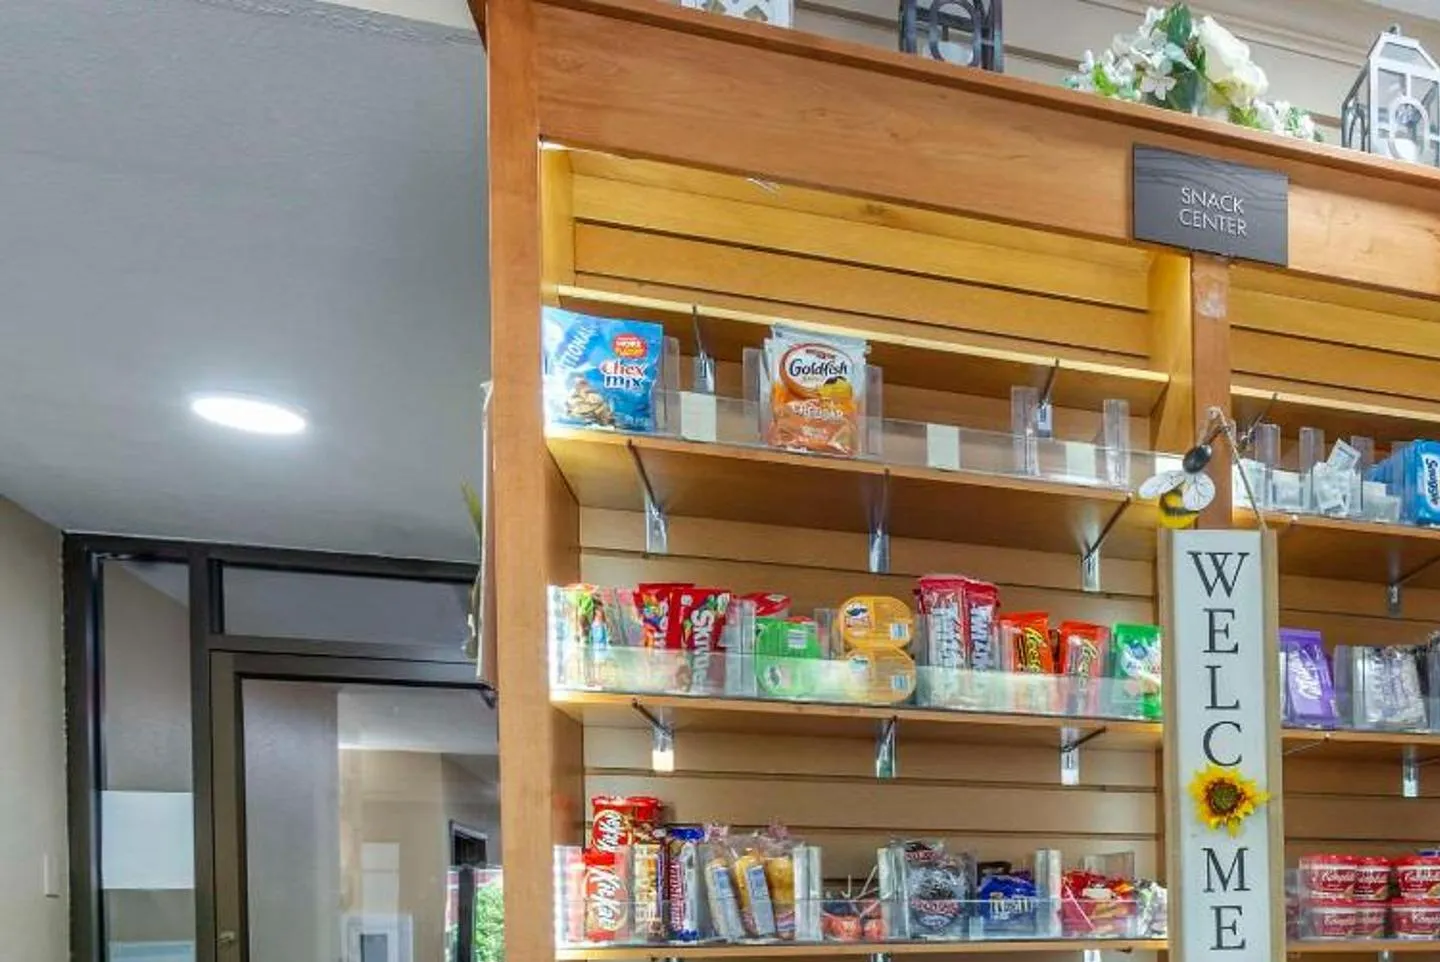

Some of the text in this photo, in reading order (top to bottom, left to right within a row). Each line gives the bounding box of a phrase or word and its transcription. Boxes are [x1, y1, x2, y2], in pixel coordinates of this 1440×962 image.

[1181, 187, 1245, 214] SNACK
[1179, 209, 1248, 237] CENTER
[789, 358, 849, 377] Goldfish
[1187, 551, 1250, 951] WELCME
